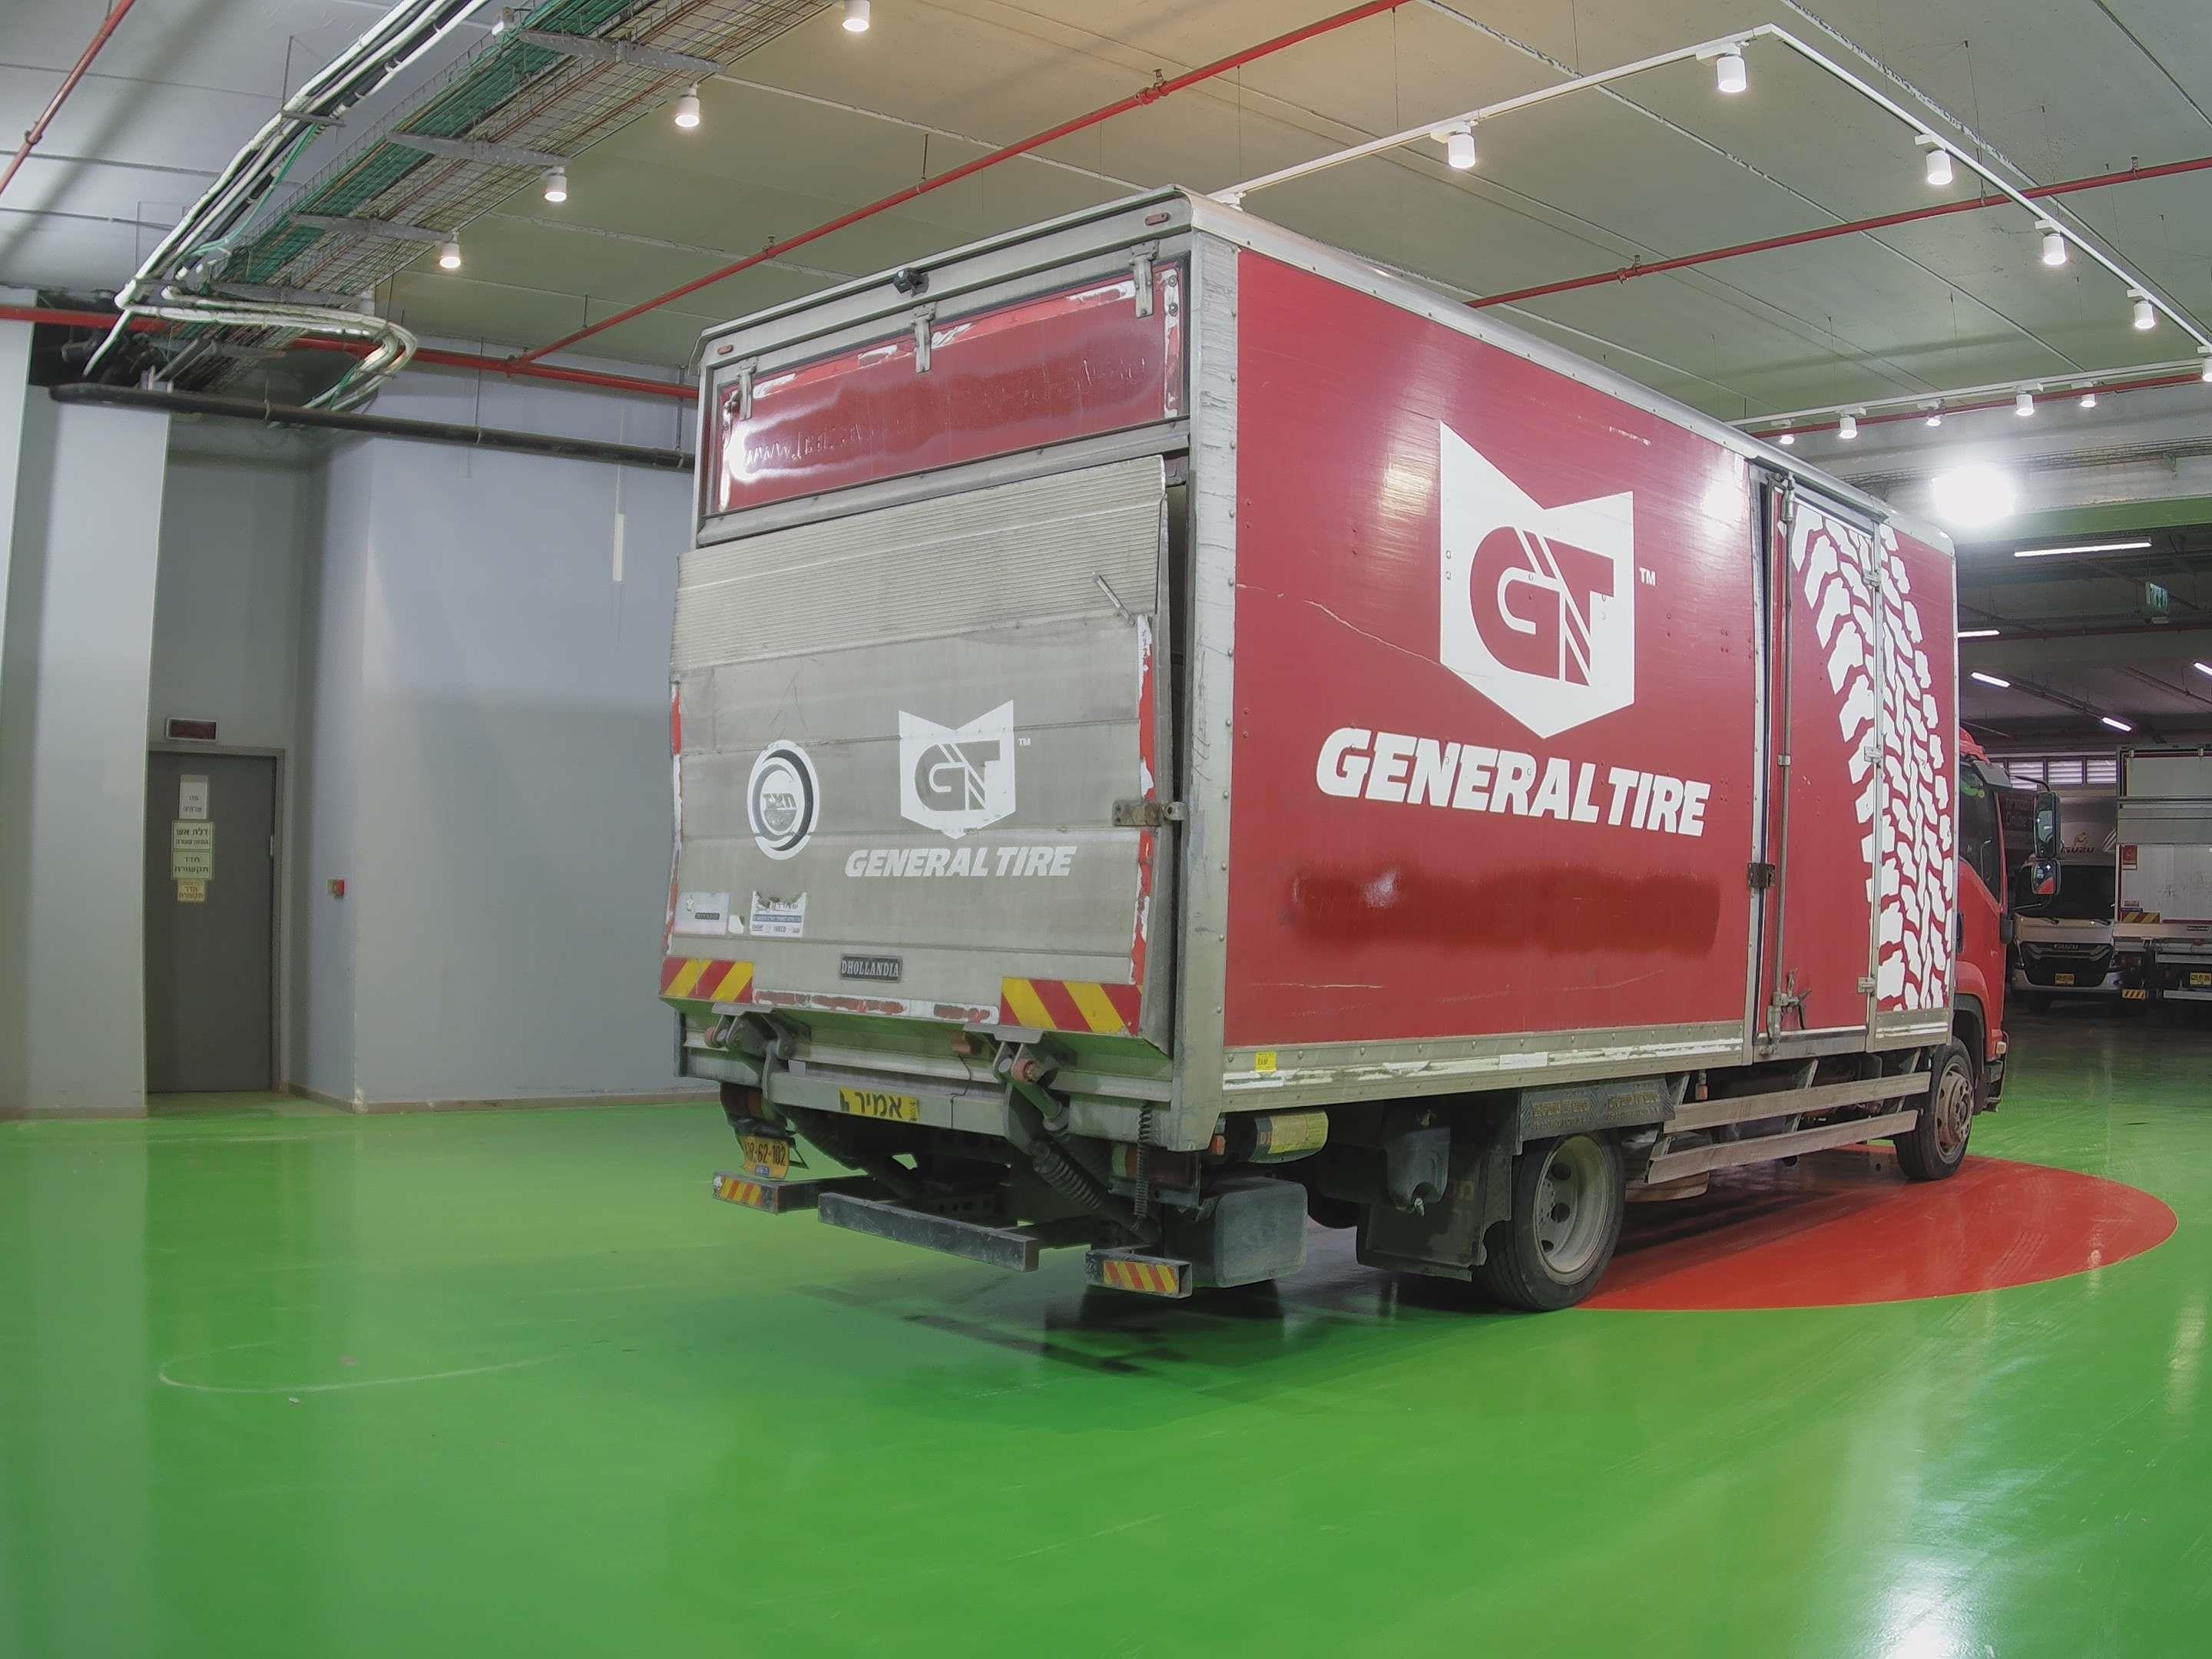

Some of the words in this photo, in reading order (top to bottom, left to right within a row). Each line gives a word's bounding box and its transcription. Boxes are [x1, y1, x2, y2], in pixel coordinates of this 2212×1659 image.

[1470, 526, 1614, 687] GT
[914, 739, 1002, 811] GT
[1316, 727, 1600, 823] GENERAL
[1607, 767, 1712, 837] TIRE
[176, 828, 190, 836] אש
[845, 847, 990, 877] GENERAL
[995, 846, 1077, 877] TIRE
[841, 959, 899, 978] DHOLLANDIA
[855, 1091, 902, 1119] אמיר
